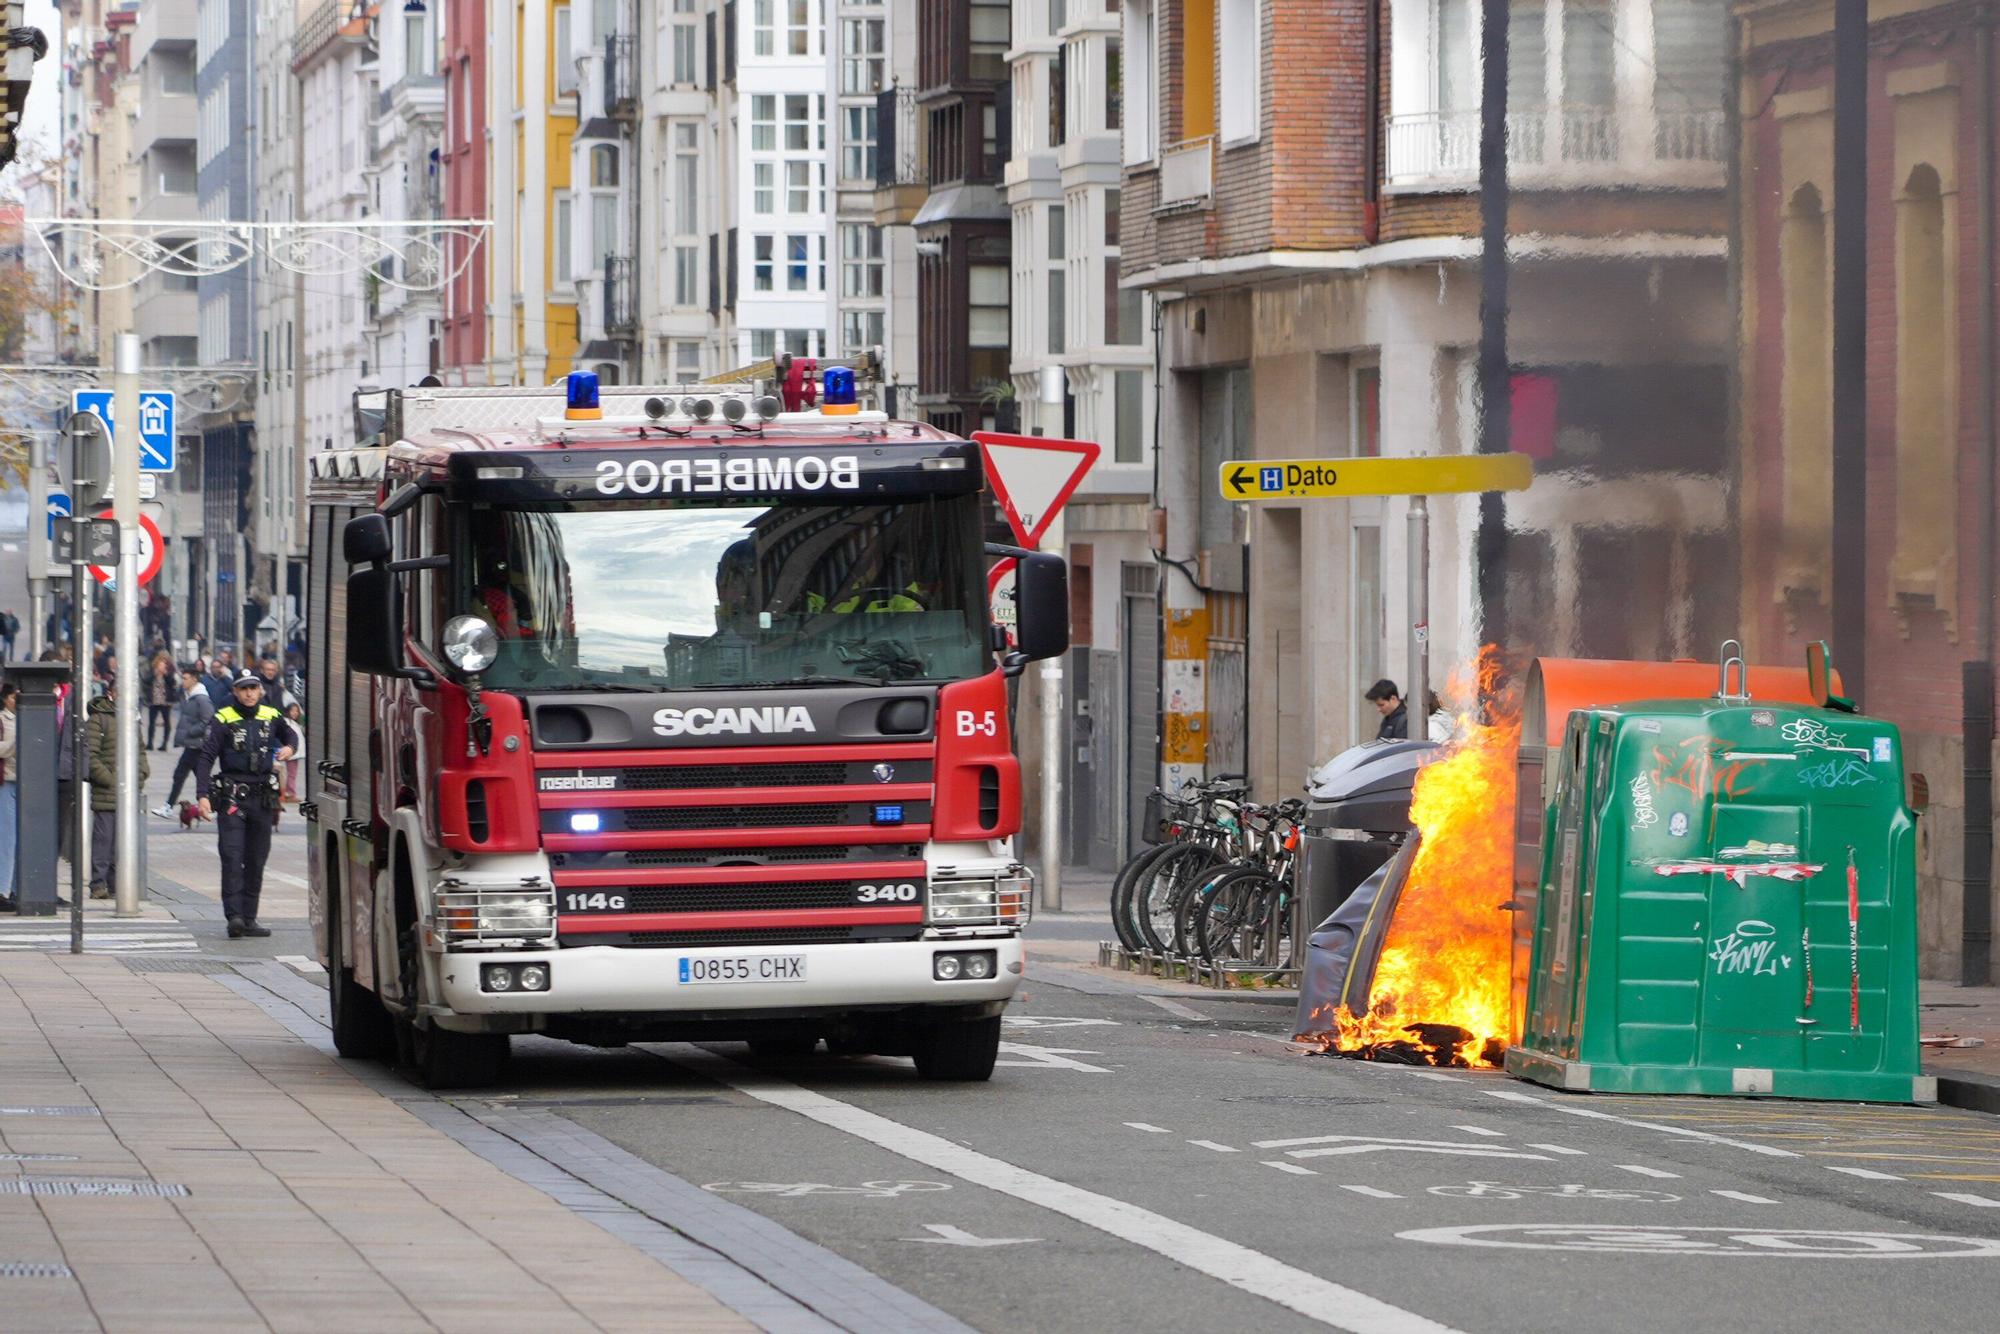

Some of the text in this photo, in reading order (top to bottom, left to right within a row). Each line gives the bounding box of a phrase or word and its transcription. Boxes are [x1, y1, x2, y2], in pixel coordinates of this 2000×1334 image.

[1287, 465, 1337, 486] Dato
[653, 706, 816, 736] SCANIA
[956, 710, 996, 737] B-5
[540, 769, 617, 790] rosenbauer
[857, 884, 917, 902] 340
[693, 957, 801, 980] 0855 CHX
